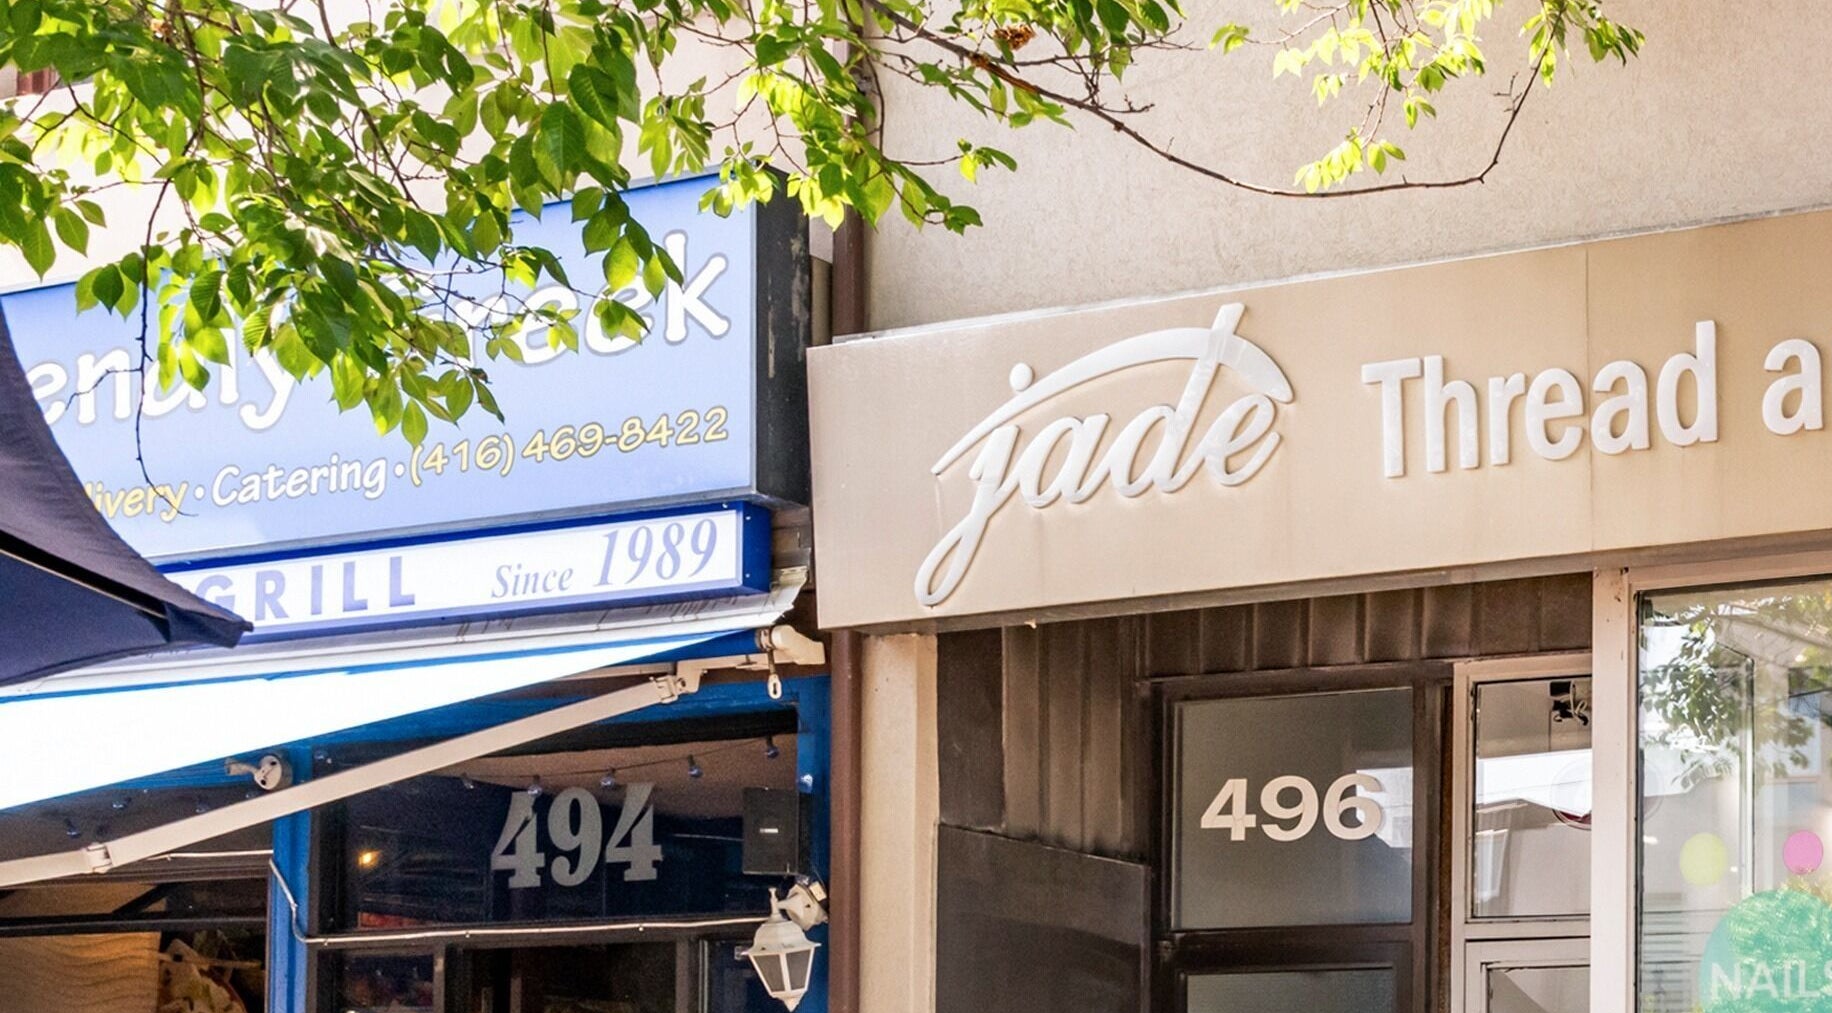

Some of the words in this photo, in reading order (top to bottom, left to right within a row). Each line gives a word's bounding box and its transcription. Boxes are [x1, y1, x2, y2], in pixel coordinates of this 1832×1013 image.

[210, 452, 388, 507] Catering
[410, 433, 514, 487] (416)
[521, 405, 729, 464] 469-8422
[914, 302, 1295, 607] jade
[1361, 319, 1718, 479] Thread
[198, 554, 416, 621] GRILL
[490, 562, 575, 599] Since
[592, 517, 719, 588] 1989
[491, 782, 664, 889] 494
[1200, 772, 1384, 842] 496
